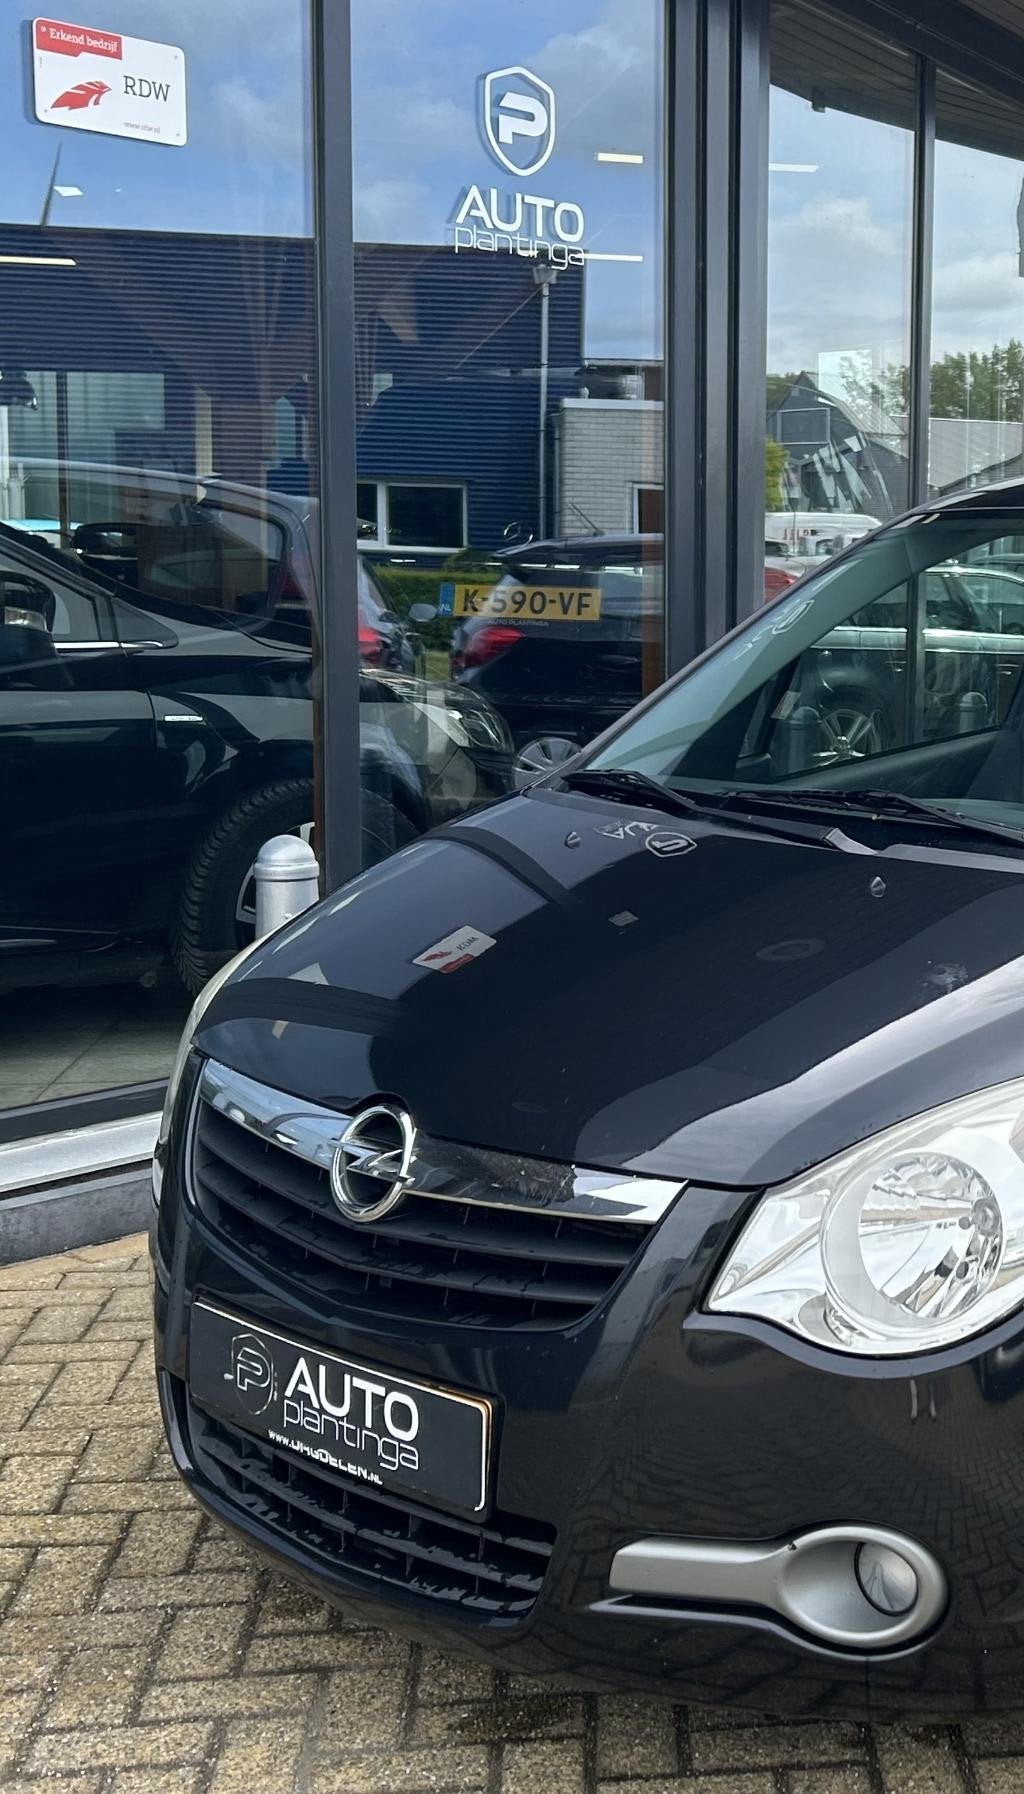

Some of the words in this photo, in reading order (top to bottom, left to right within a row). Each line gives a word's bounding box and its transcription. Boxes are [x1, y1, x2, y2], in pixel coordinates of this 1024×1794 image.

[50, 28, 85, 45] Erkend
[86, 35, 118, 53] bedrijf
[123, 75, 171, 102] RDW
[456, 185, 585, 243] AUTO
[454, 225, 585, 271] plantinga
[463, 588, 593, 616] K-590-VF
[284, 1357, 419, 1442] AUTO
[283, 1400, 419, 1471] plantinga
